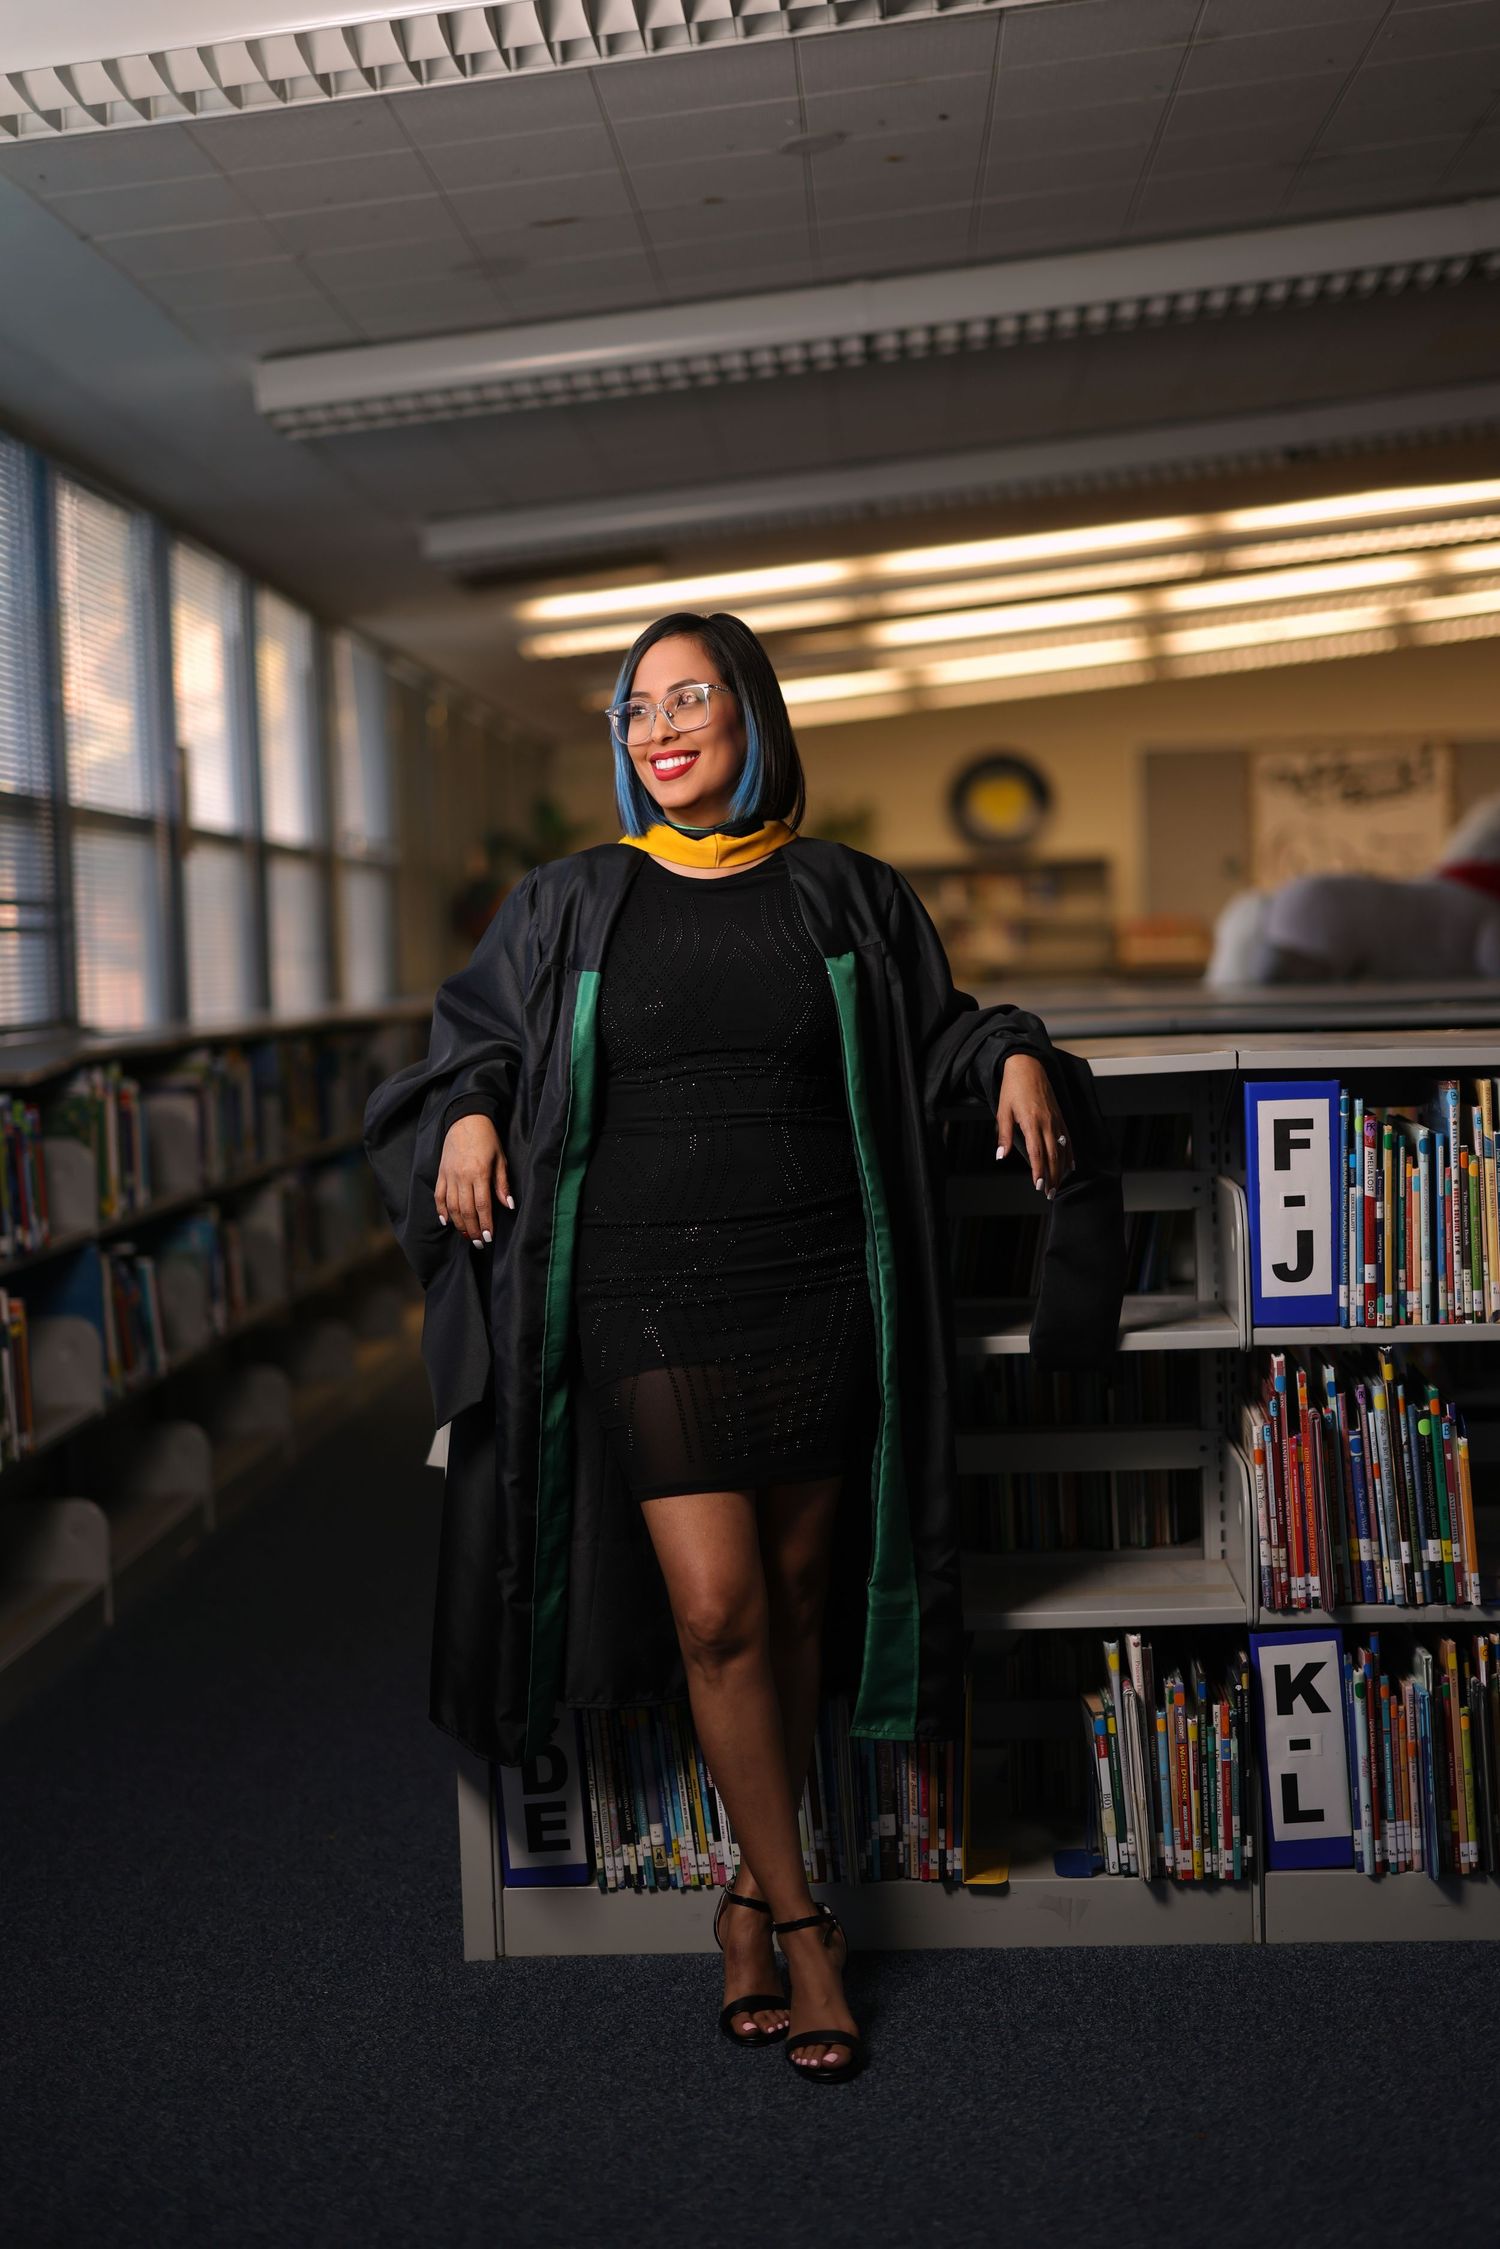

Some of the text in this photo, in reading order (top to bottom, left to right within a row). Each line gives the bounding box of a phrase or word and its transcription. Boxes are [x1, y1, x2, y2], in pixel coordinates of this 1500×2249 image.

[1273, 1118, 1314, 1171] F
[1272, 1230, 1314, 1283] J
[1271, 1402, 1278, 1413] B
[1265, 1427, 1271, 1438] B
[1444, 1424, 1450, 1436] B
[1256, 1474, 1264, 1495] Thank
[1273, 1661, 1332, 1716] K
[1280, 1773, 1325, 1824] L
[524, 1801, 571, 1853] E
[601, 1804, 610, 1844] WASHINGTON
[624, 1809, 632, 1832] CARVER
